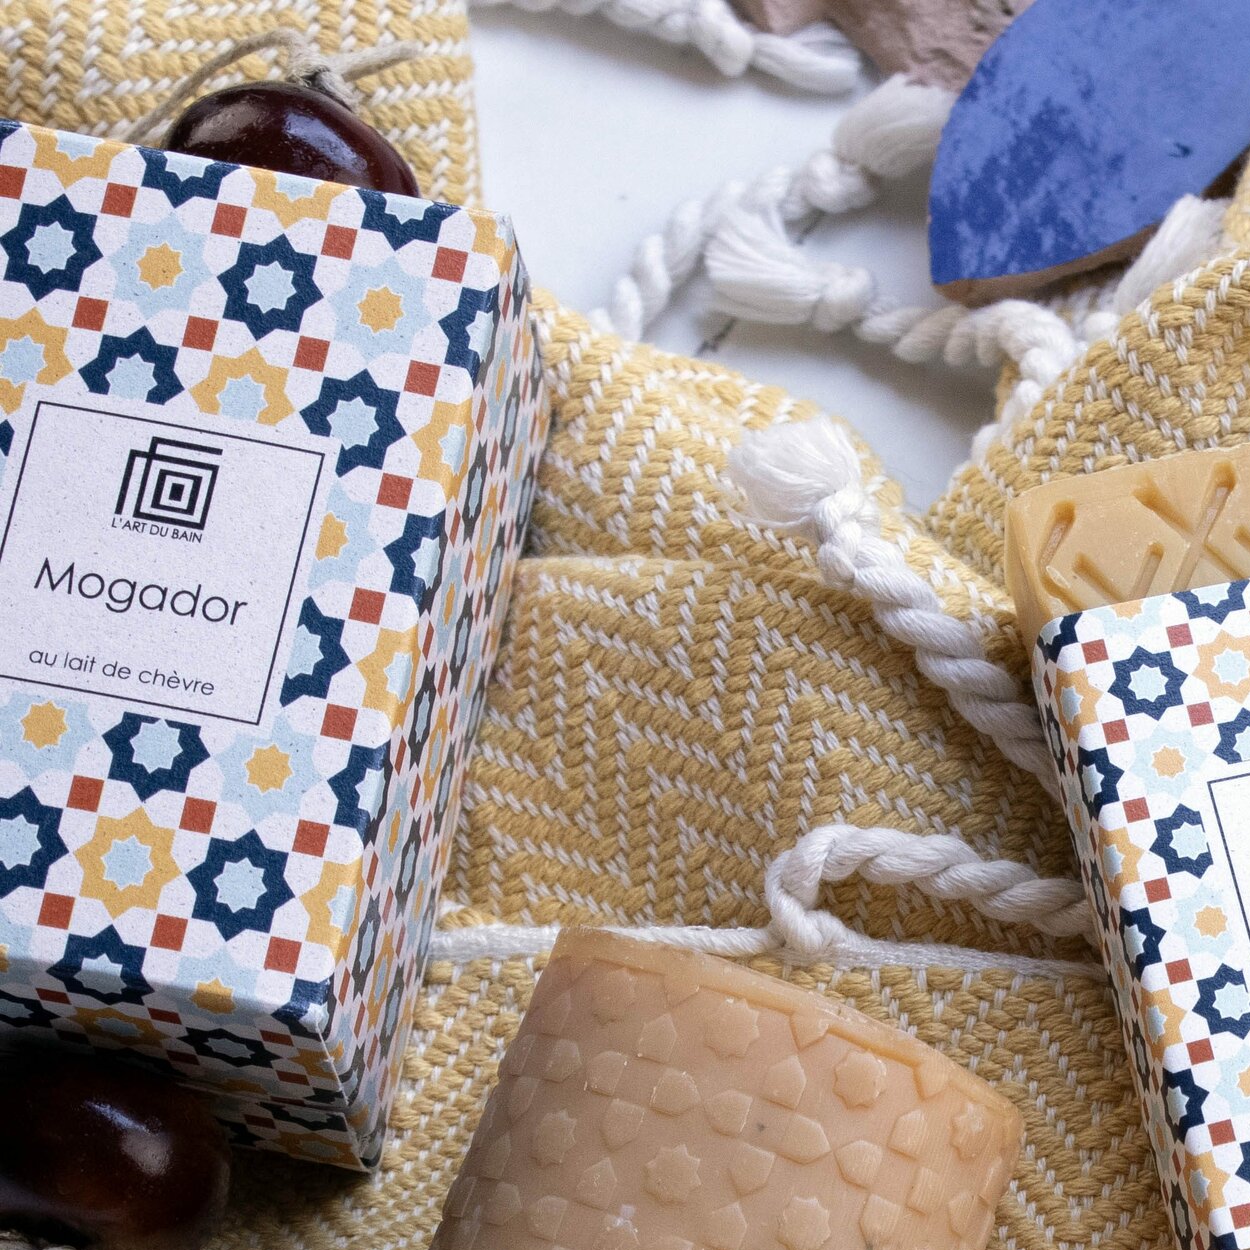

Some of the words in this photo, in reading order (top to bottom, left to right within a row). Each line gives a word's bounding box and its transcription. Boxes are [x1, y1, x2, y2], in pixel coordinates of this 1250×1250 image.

[111, 517, 148, 533] L'ART
[149, 523, 169, 538] DU
[170, 528, 203, 544] BAIN
[33, 557, 249, 626] Mogador
[28, 650, 58, 668] au
[63, 652, 97, 674] lait
[101, 660, 132, 680] de
[138, 668, 215, 696] chèvre
